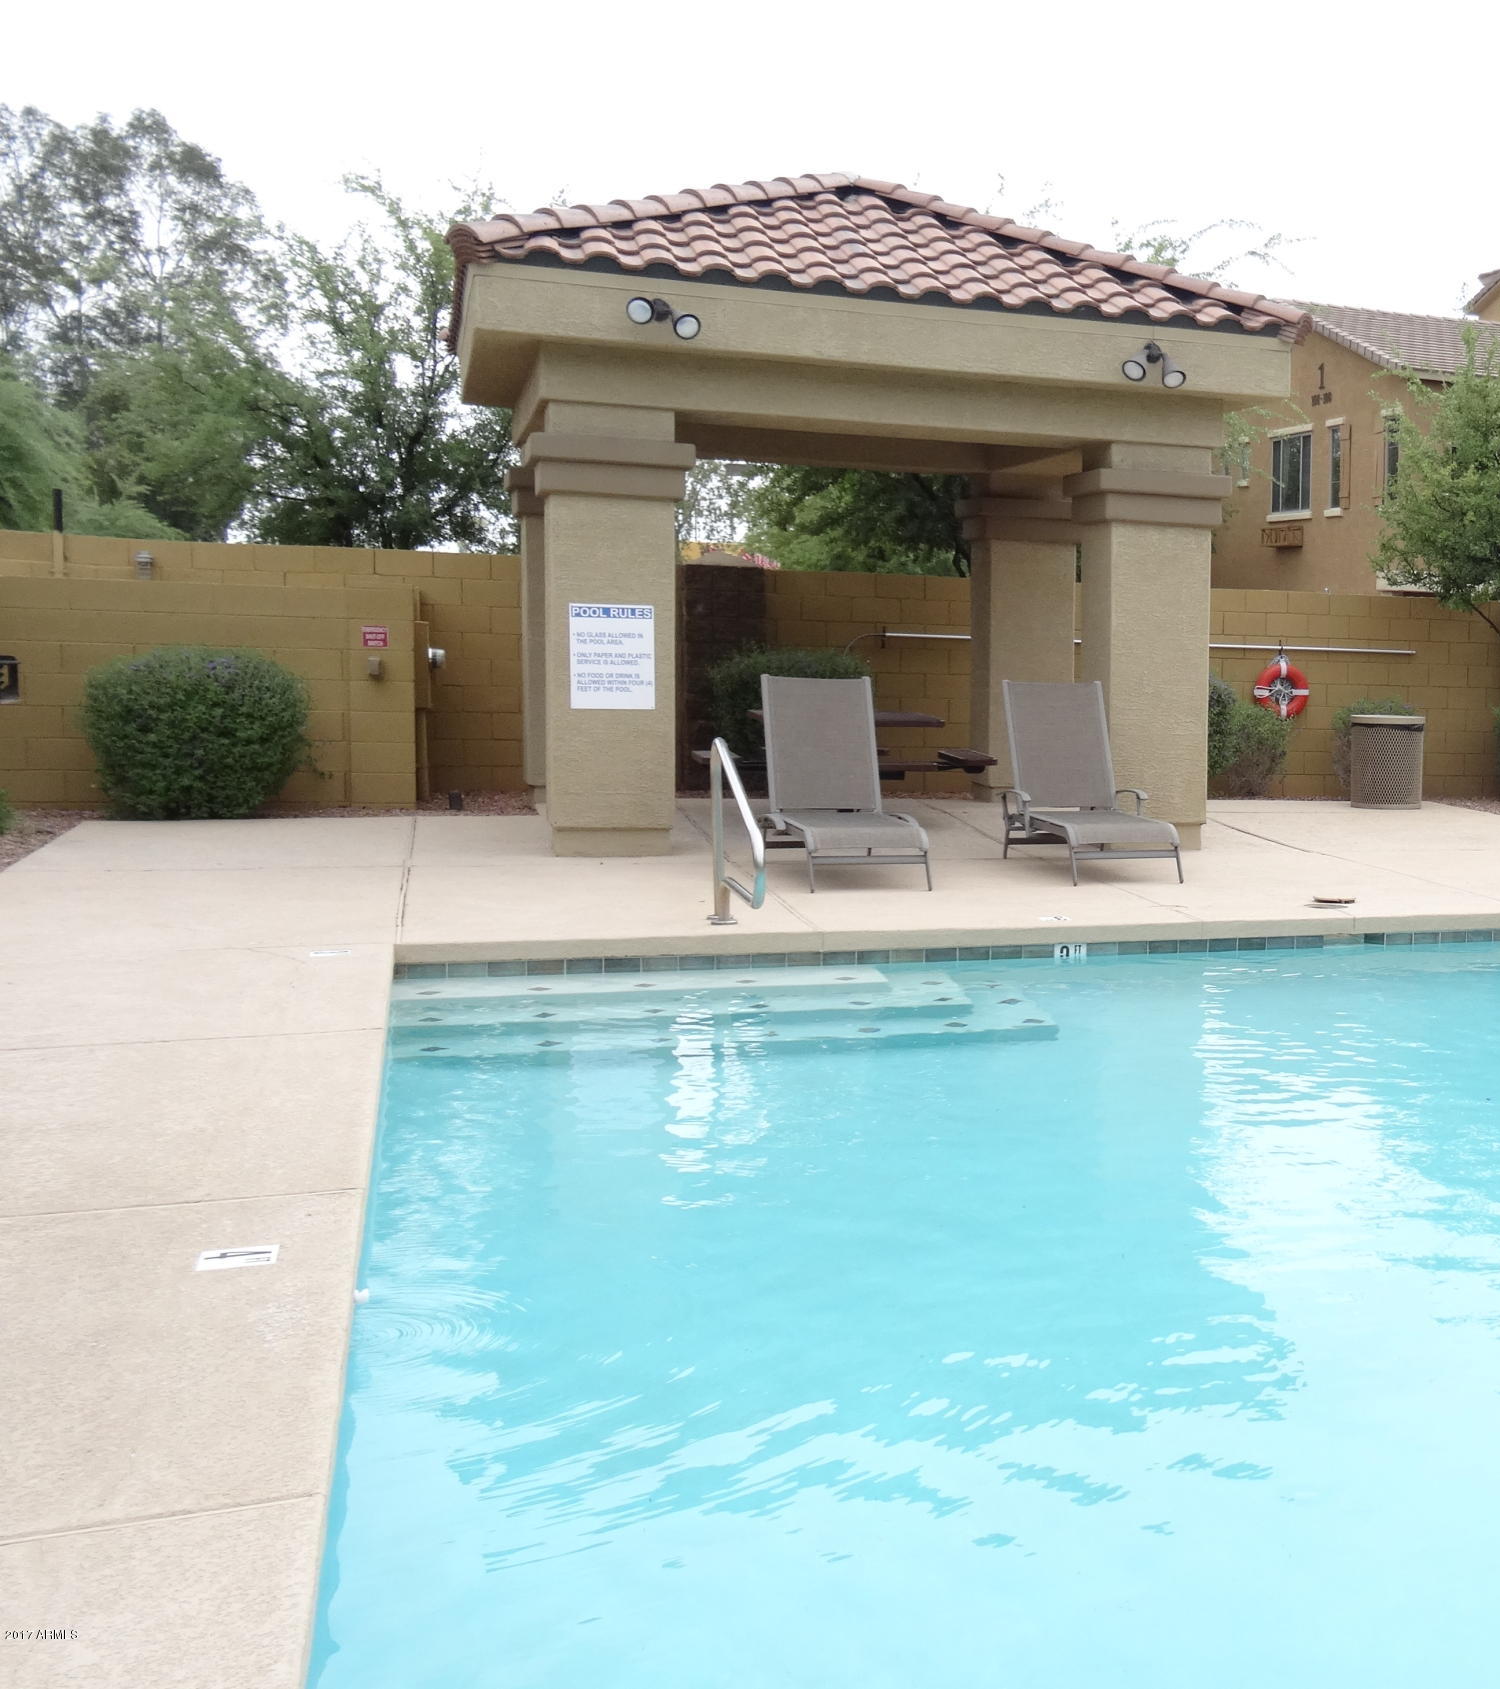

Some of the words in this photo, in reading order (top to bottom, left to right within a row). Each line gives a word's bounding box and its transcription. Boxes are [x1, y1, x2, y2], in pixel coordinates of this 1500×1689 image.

[1318, 362, 1326, 390] 1
[572, 607, 608, 618] POOL
[610, 608, 652, 619] RULES
